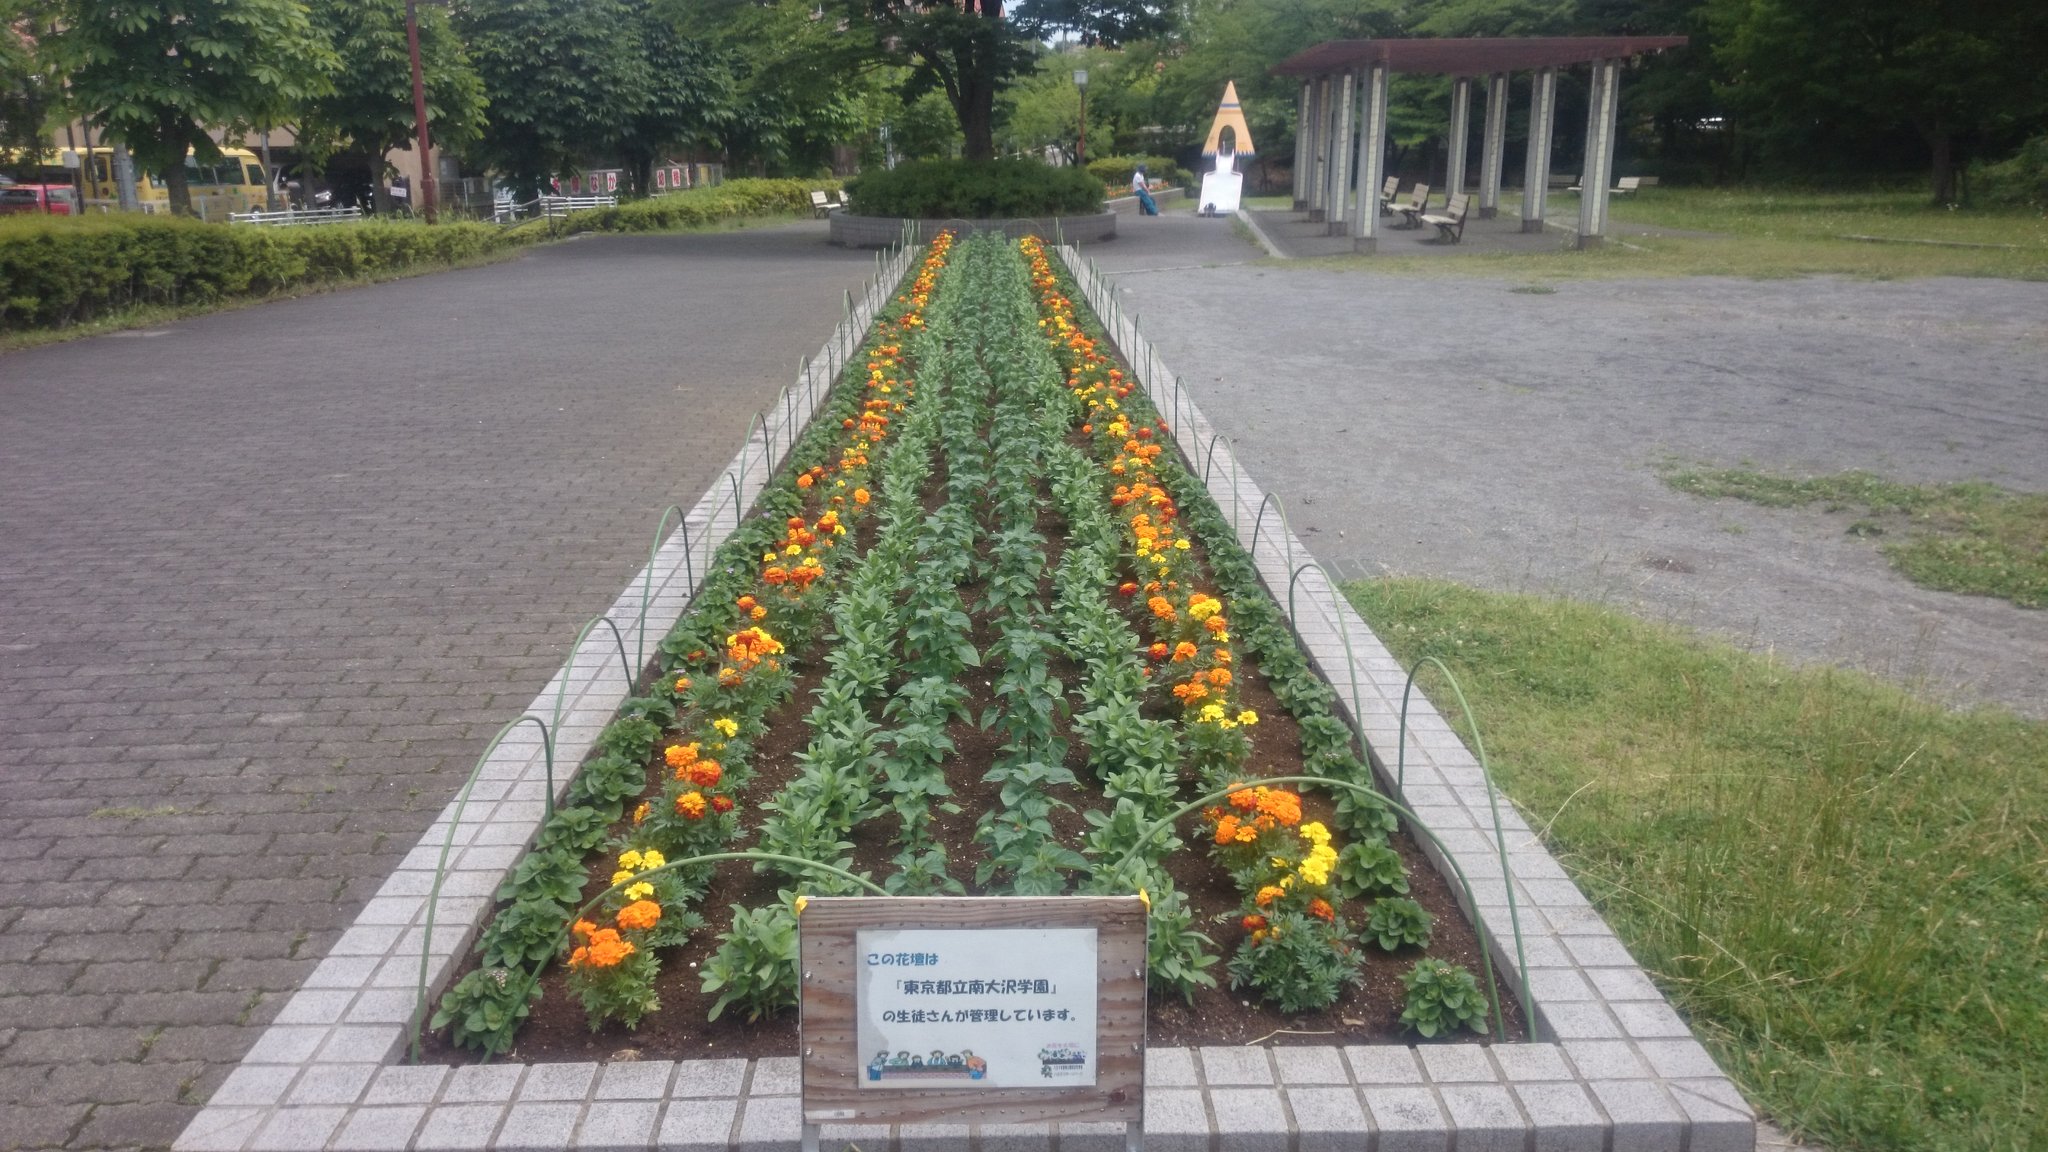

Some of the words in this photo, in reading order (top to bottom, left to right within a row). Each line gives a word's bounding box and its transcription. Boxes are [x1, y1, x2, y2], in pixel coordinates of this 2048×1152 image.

[867, 952, 938, 966] この花壇は
[896, 979, 1057, 995] 『東京都立南大沢学園』
[882, 1008, 1077, 1023] の生徒さんが管理しています。
